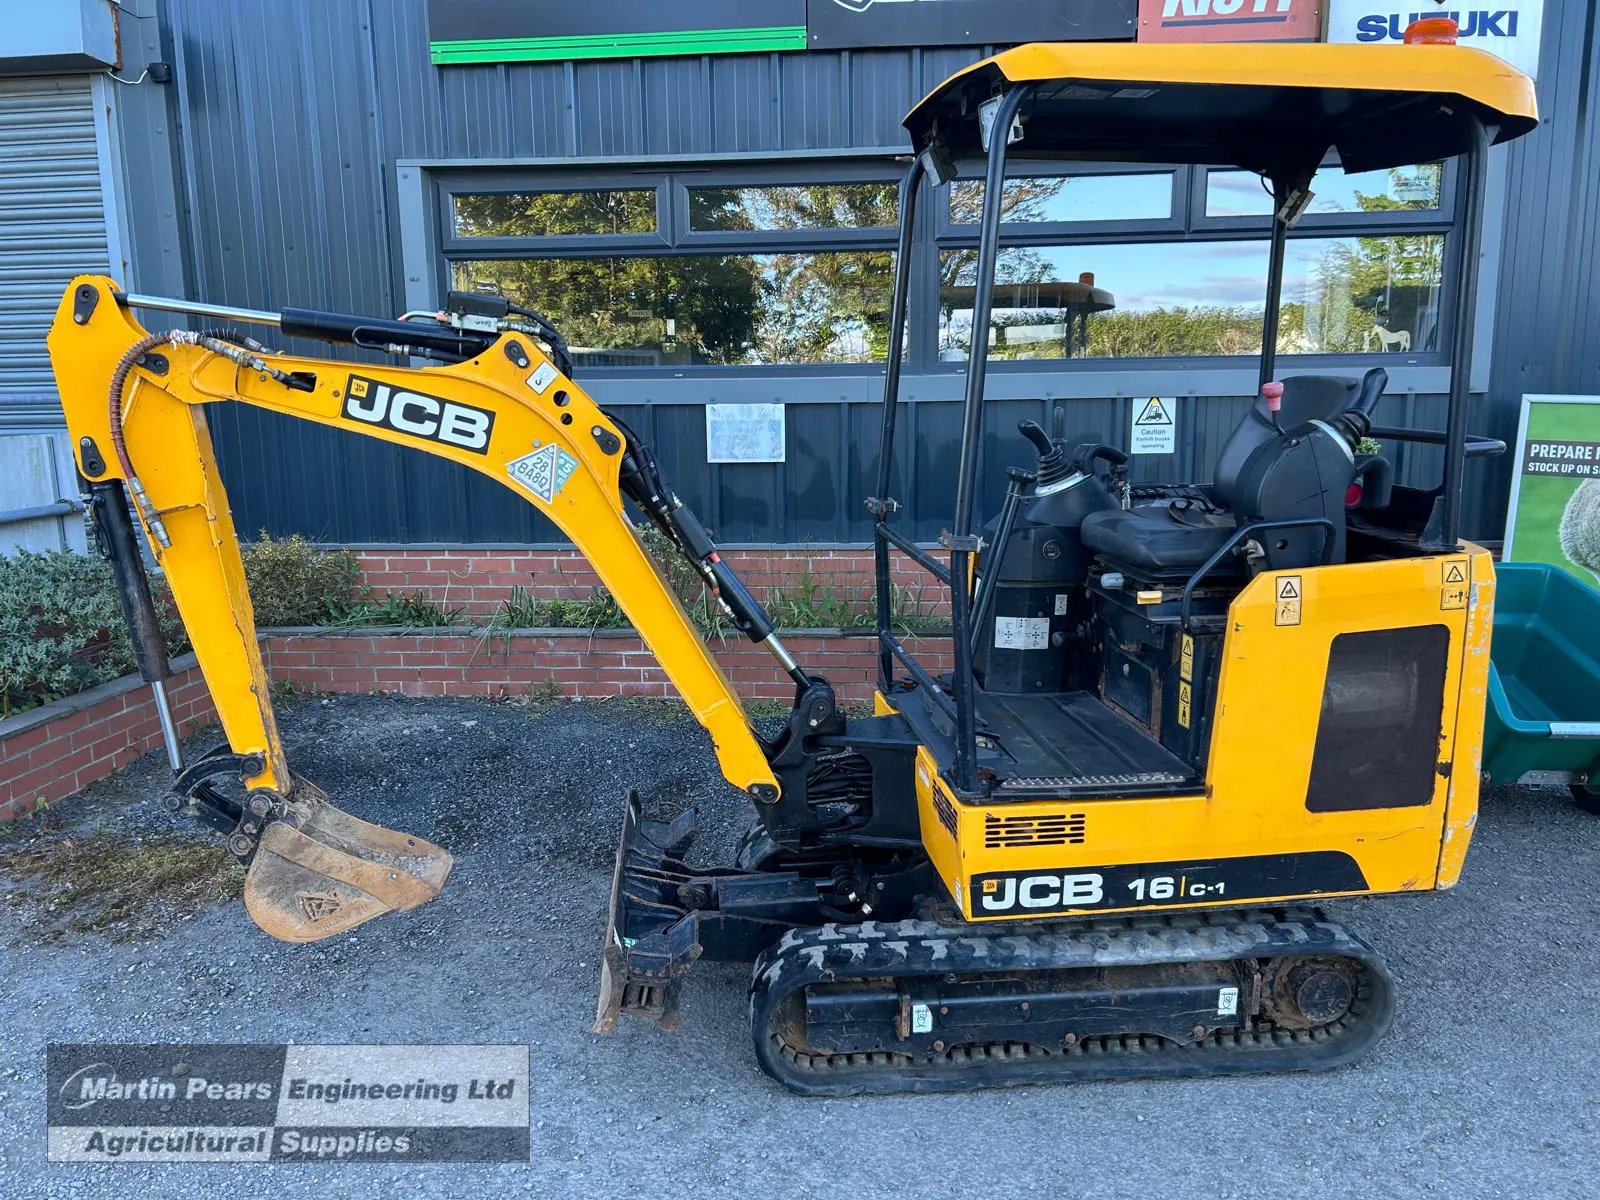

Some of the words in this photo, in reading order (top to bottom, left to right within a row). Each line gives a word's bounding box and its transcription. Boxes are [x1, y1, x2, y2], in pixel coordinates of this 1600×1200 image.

[1356, 11, 1518, 42] SUUKI
[347, 385, 489, 449] JCB
[1530, 444, 1593, 459] PREPARE
[532, 457, 549, 473] 28
[1528, 462, 1560, 473] STOCK
[1561, 463, 1575, 474] UP
[1576, 464, 1591, 474] ON
[982, 873, 1103, 911] JCB
